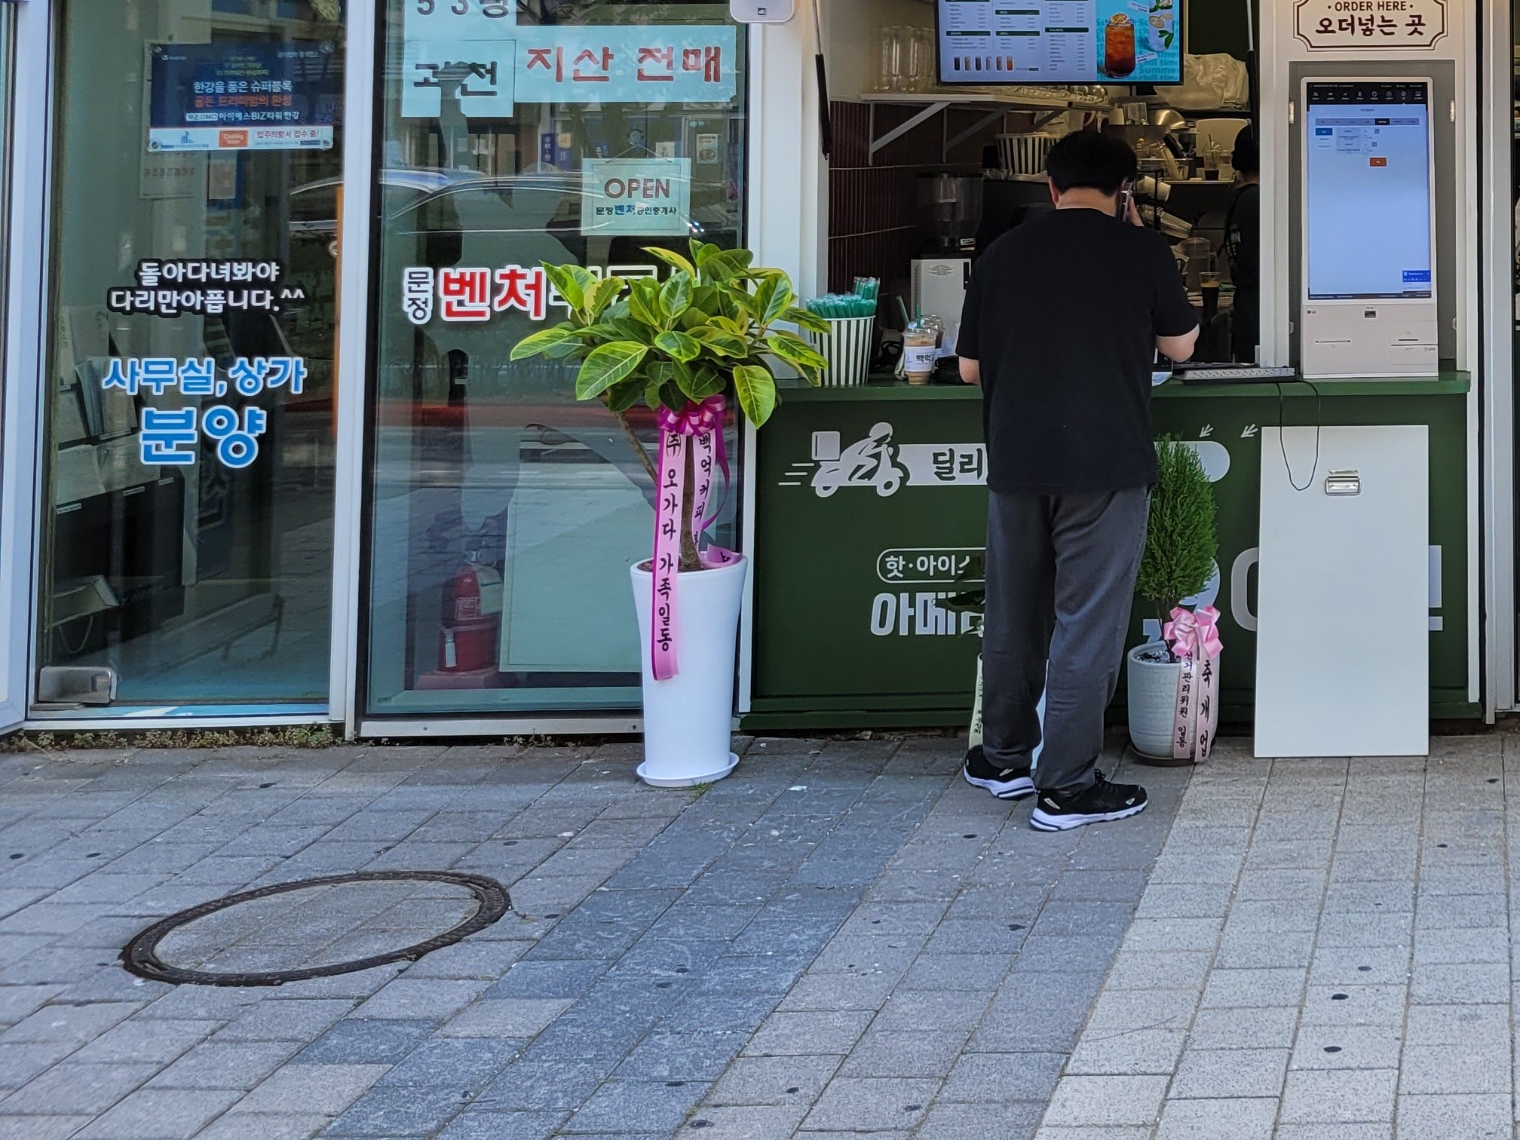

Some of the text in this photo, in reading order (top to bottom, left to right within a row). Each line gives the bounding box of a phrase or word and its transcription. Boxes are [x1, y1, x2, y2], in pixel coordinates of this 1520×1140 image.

[1334, 1, 1407, 11] ORDER HERE
[1315, 14, 1427, 36] 오더넣는 곳
[527, 46, 721, 83] 지산 전매
[604, 177, 670, 199] OPEN
[139, 262, 280, 287] 돌아다녀봐야
[140, 405, 267, 468] 분양
